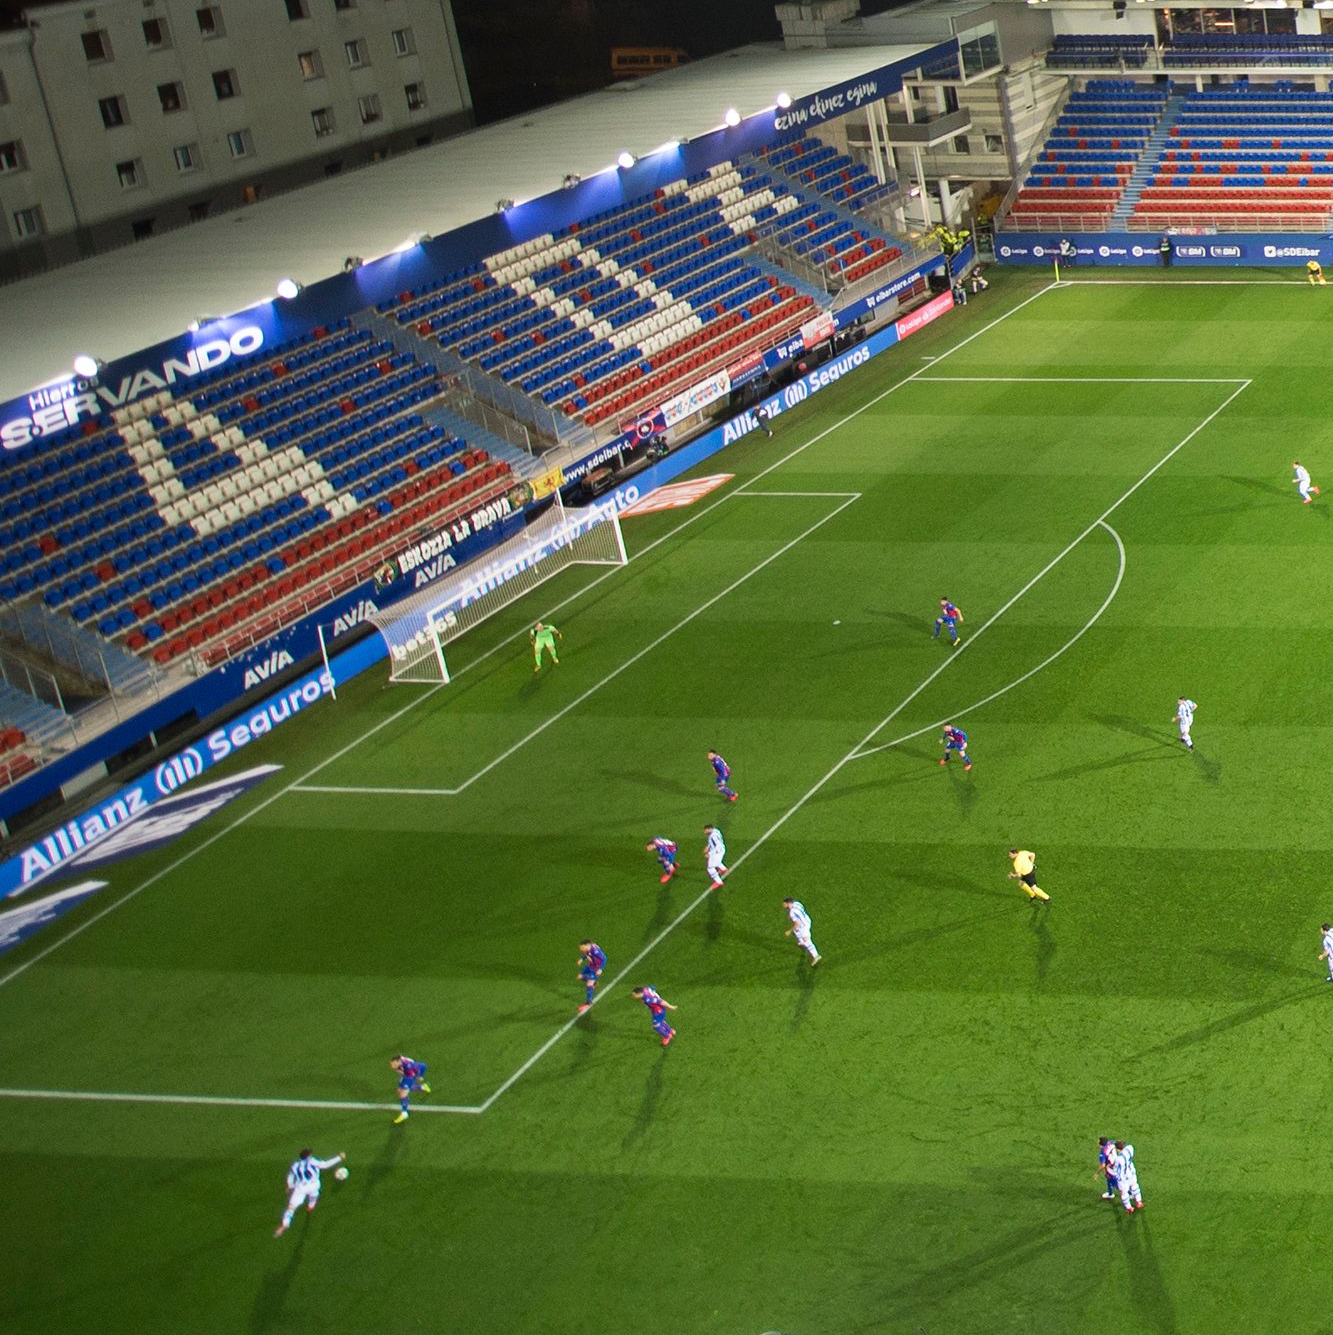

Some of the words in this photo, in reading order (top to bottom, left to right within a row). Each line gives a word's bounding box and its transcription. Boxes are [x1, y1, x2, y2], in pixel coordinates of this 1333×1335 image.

[1276, 248, 1320, 257] @SDEibar
[0, 326, 264, 450] SERVANDO
[28, 375, 99, 410] Hierros
[808, 346, 870, 394] Seguros
[452, 520, 472, 543] LA
[471, 497, 512, 532] BRAVA
[20, 786, 149, 883] Allianz
[208, 669, 336, 762] Seguros
